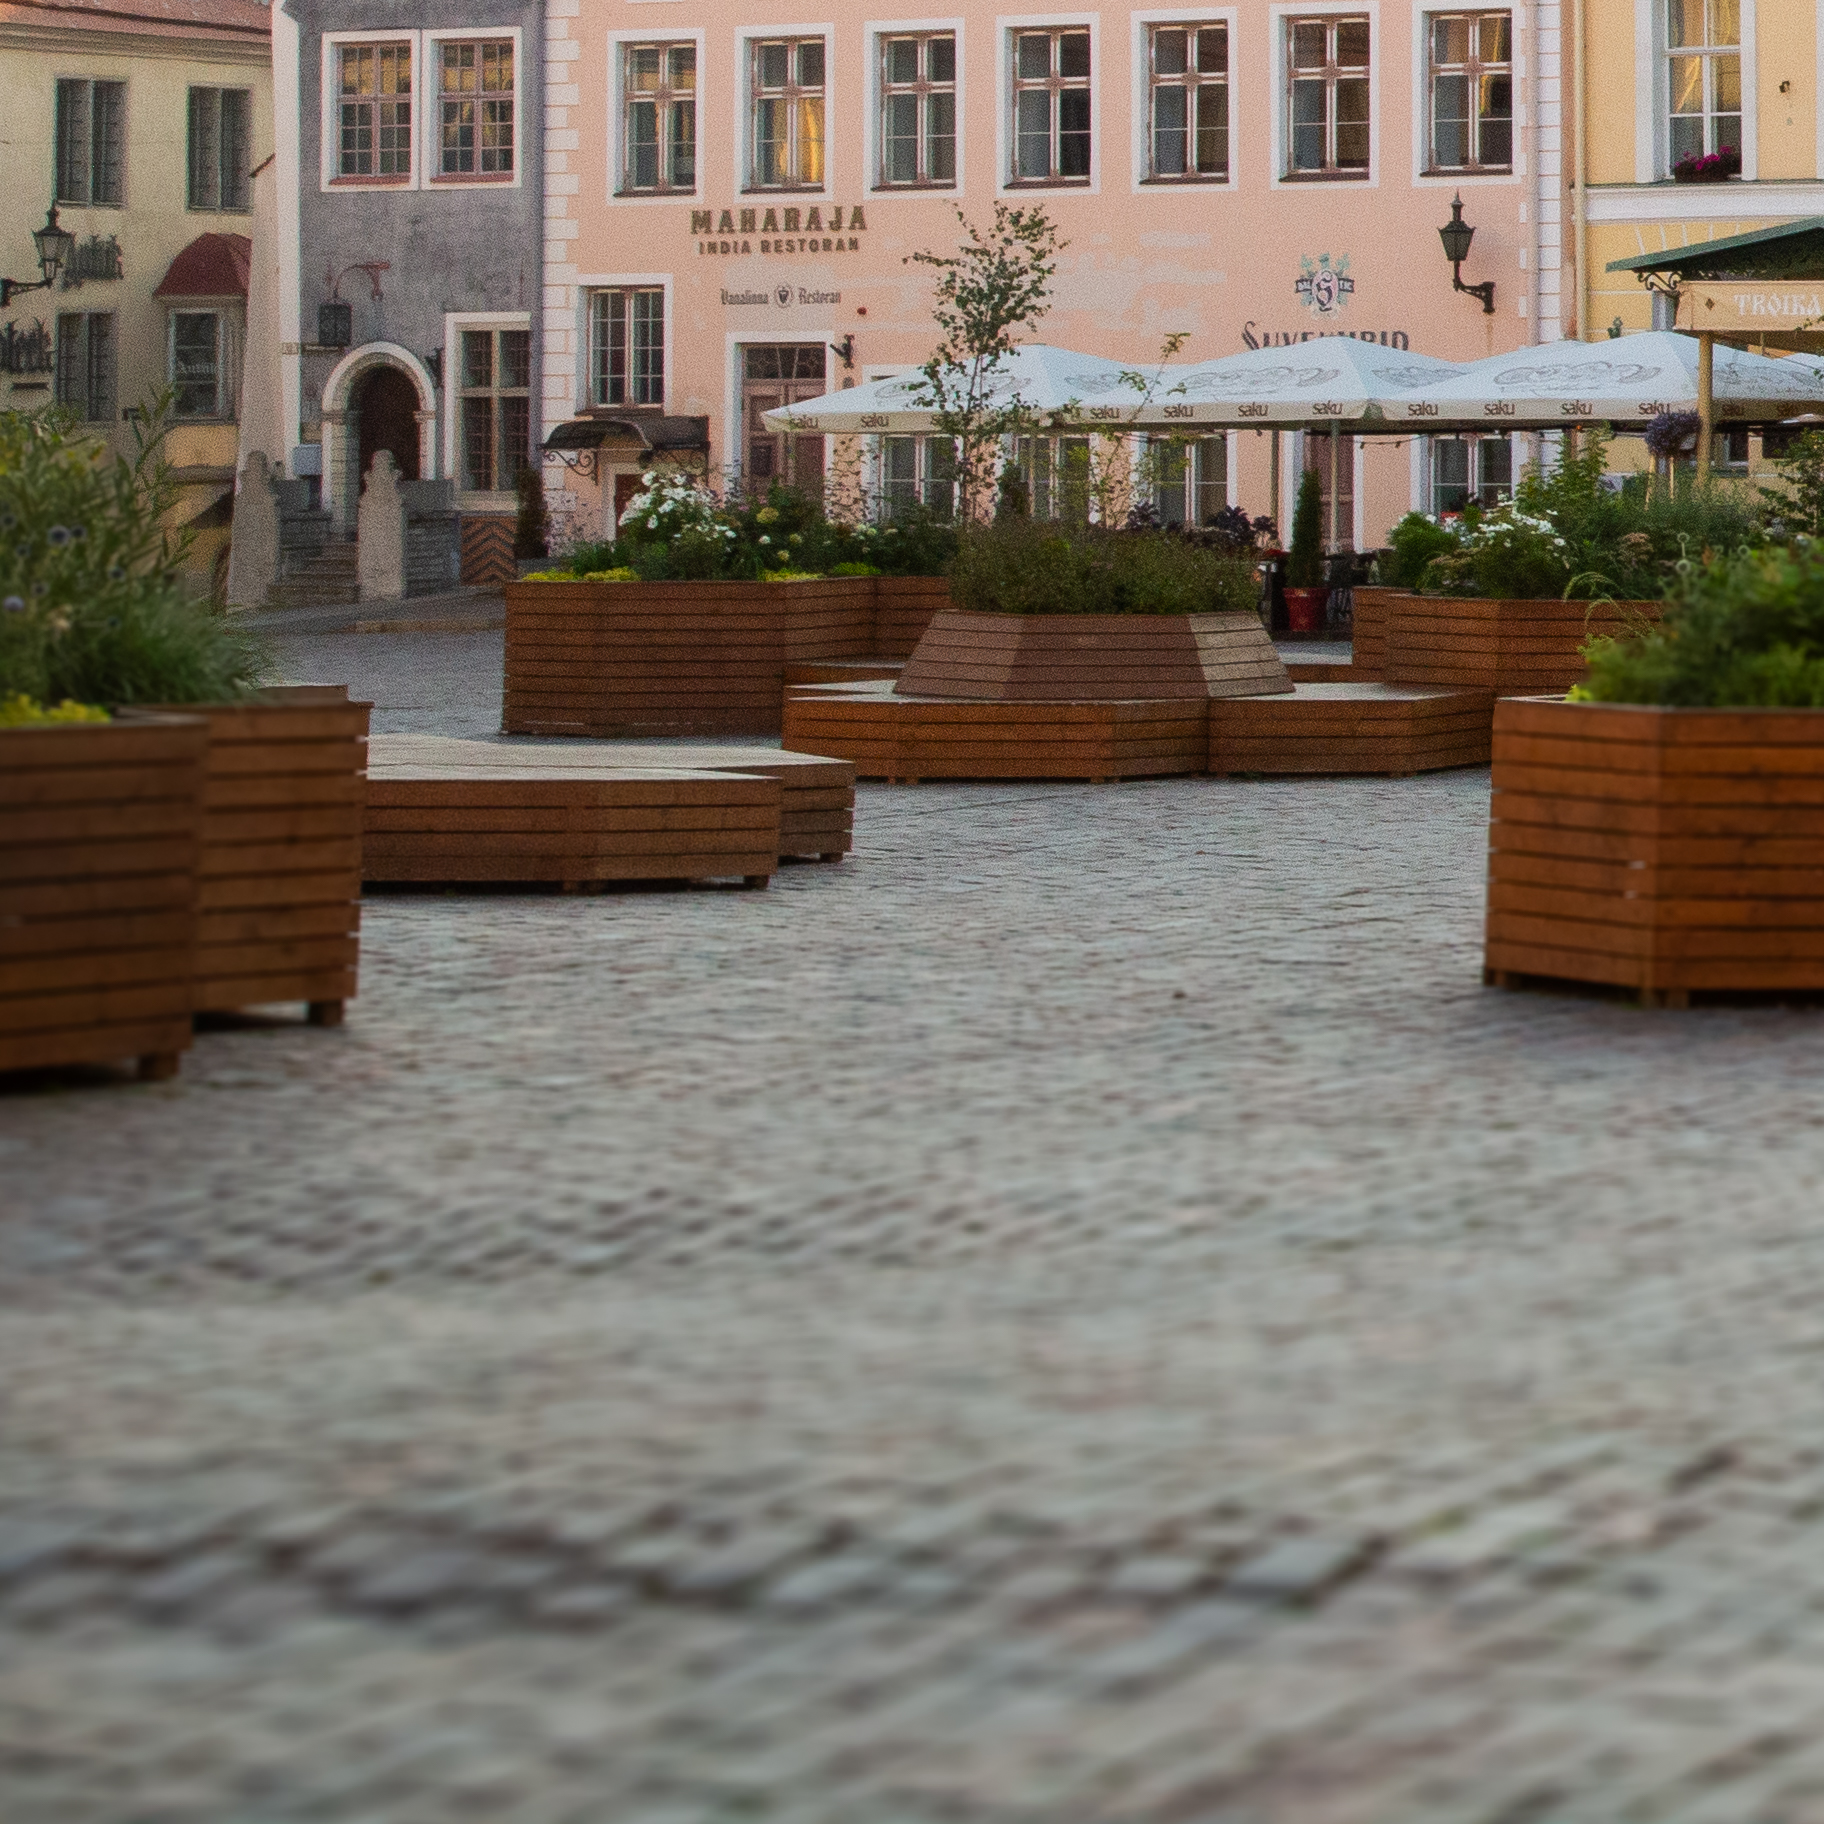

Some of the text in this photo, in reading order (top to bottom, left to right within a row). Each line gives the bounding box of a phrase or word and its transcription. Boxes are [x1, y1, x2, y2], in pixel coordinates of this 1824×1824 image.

[691, 205, 867, 234] MAHARAJA
[699, 237, 858, 255] INDIA RESTORAN
[799, 287, 841, 304] Restoran
[1733, 293, 1822, 317] TROIKA
[1090, 399, 1343, 420] saku saku saku saku
[1408, 400, 1438, 416] saku
[1484, 400, 1515, 416] saku
[1561, 399, 1593, 416] saku
[1638, 399, 1671, 416] saku
[861, 412, 890, 428] saku
